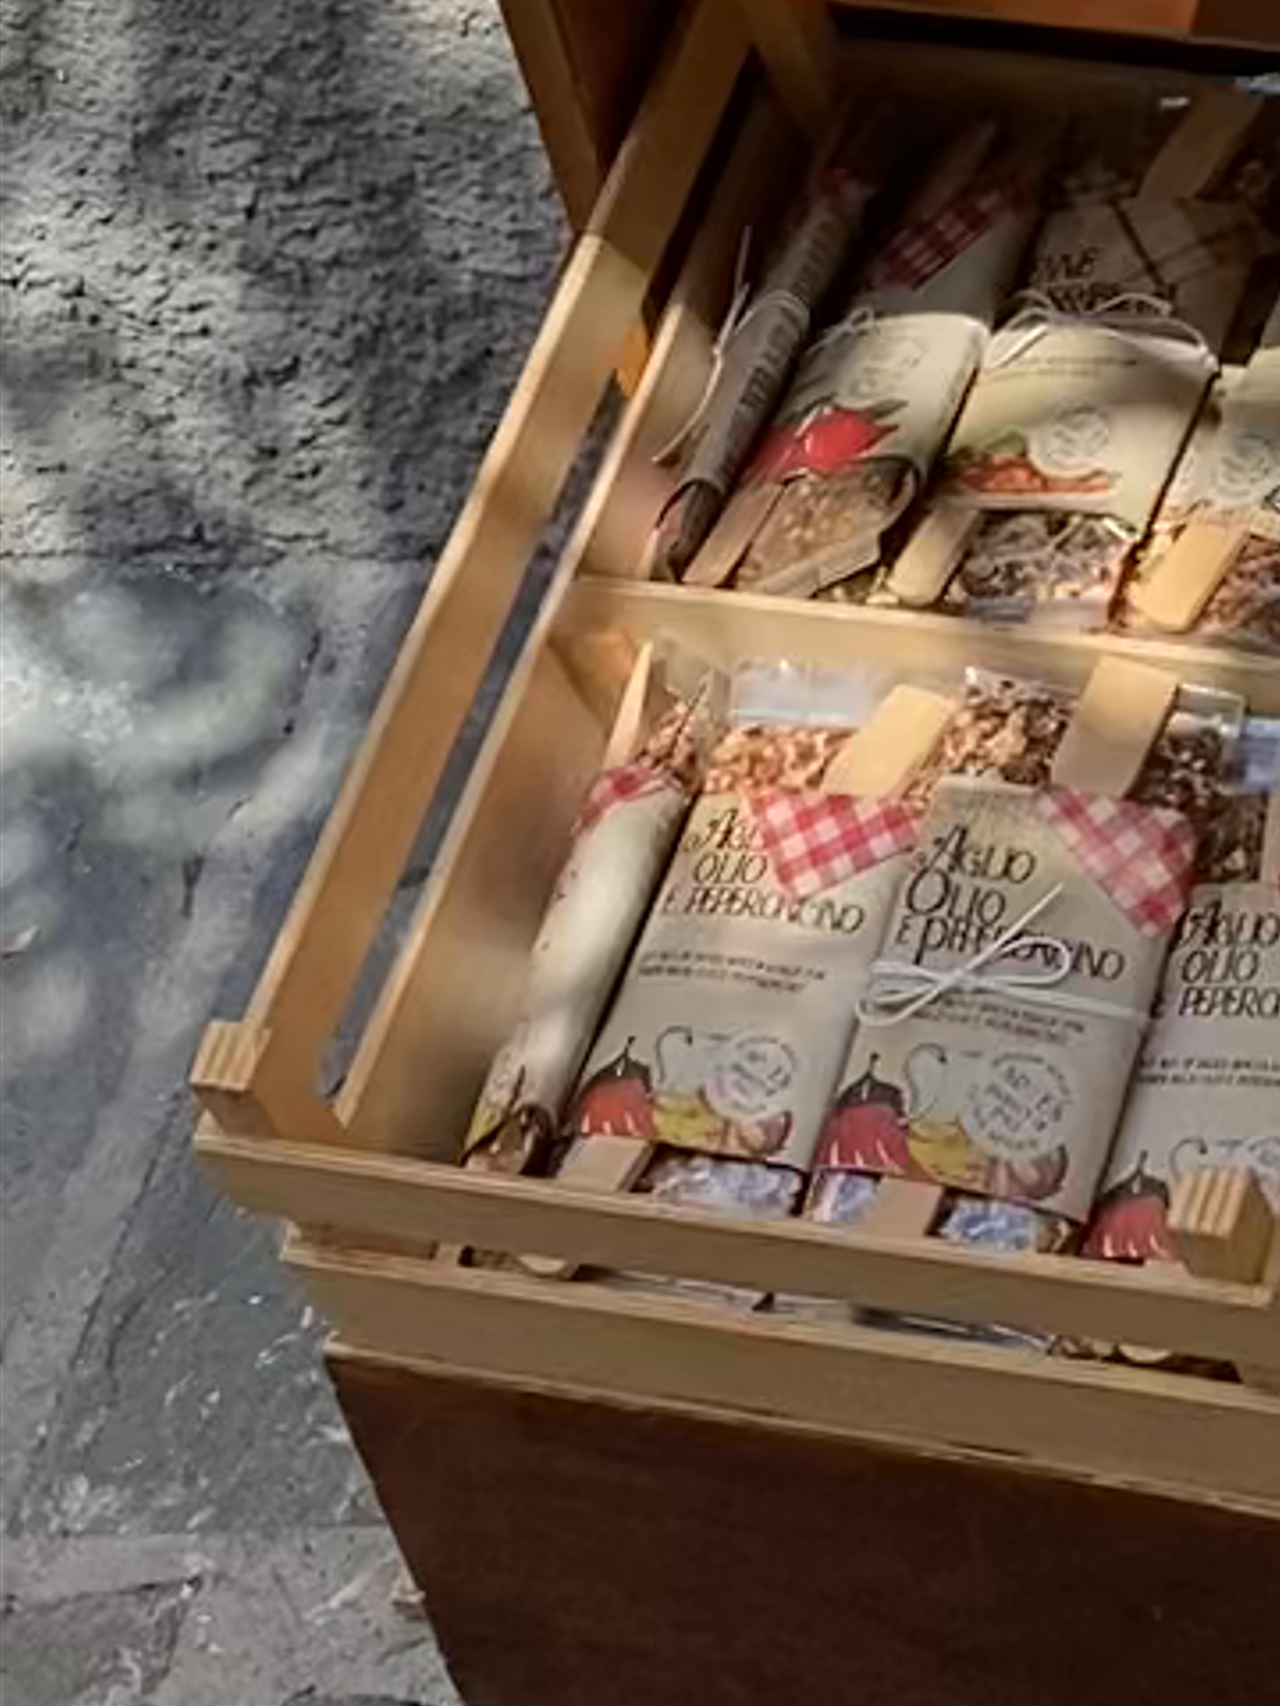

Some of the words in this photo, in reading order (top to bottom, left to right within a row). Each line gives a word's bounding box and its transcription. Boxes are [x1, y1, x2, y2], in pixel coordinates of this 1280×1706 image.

[692, 851, 768, 885] OLIO
[920, 824, 1037, 885] AGLIO
[906, 864, 1007, 927] OLIO
[1181, 949, 1260, 984] OLIO
